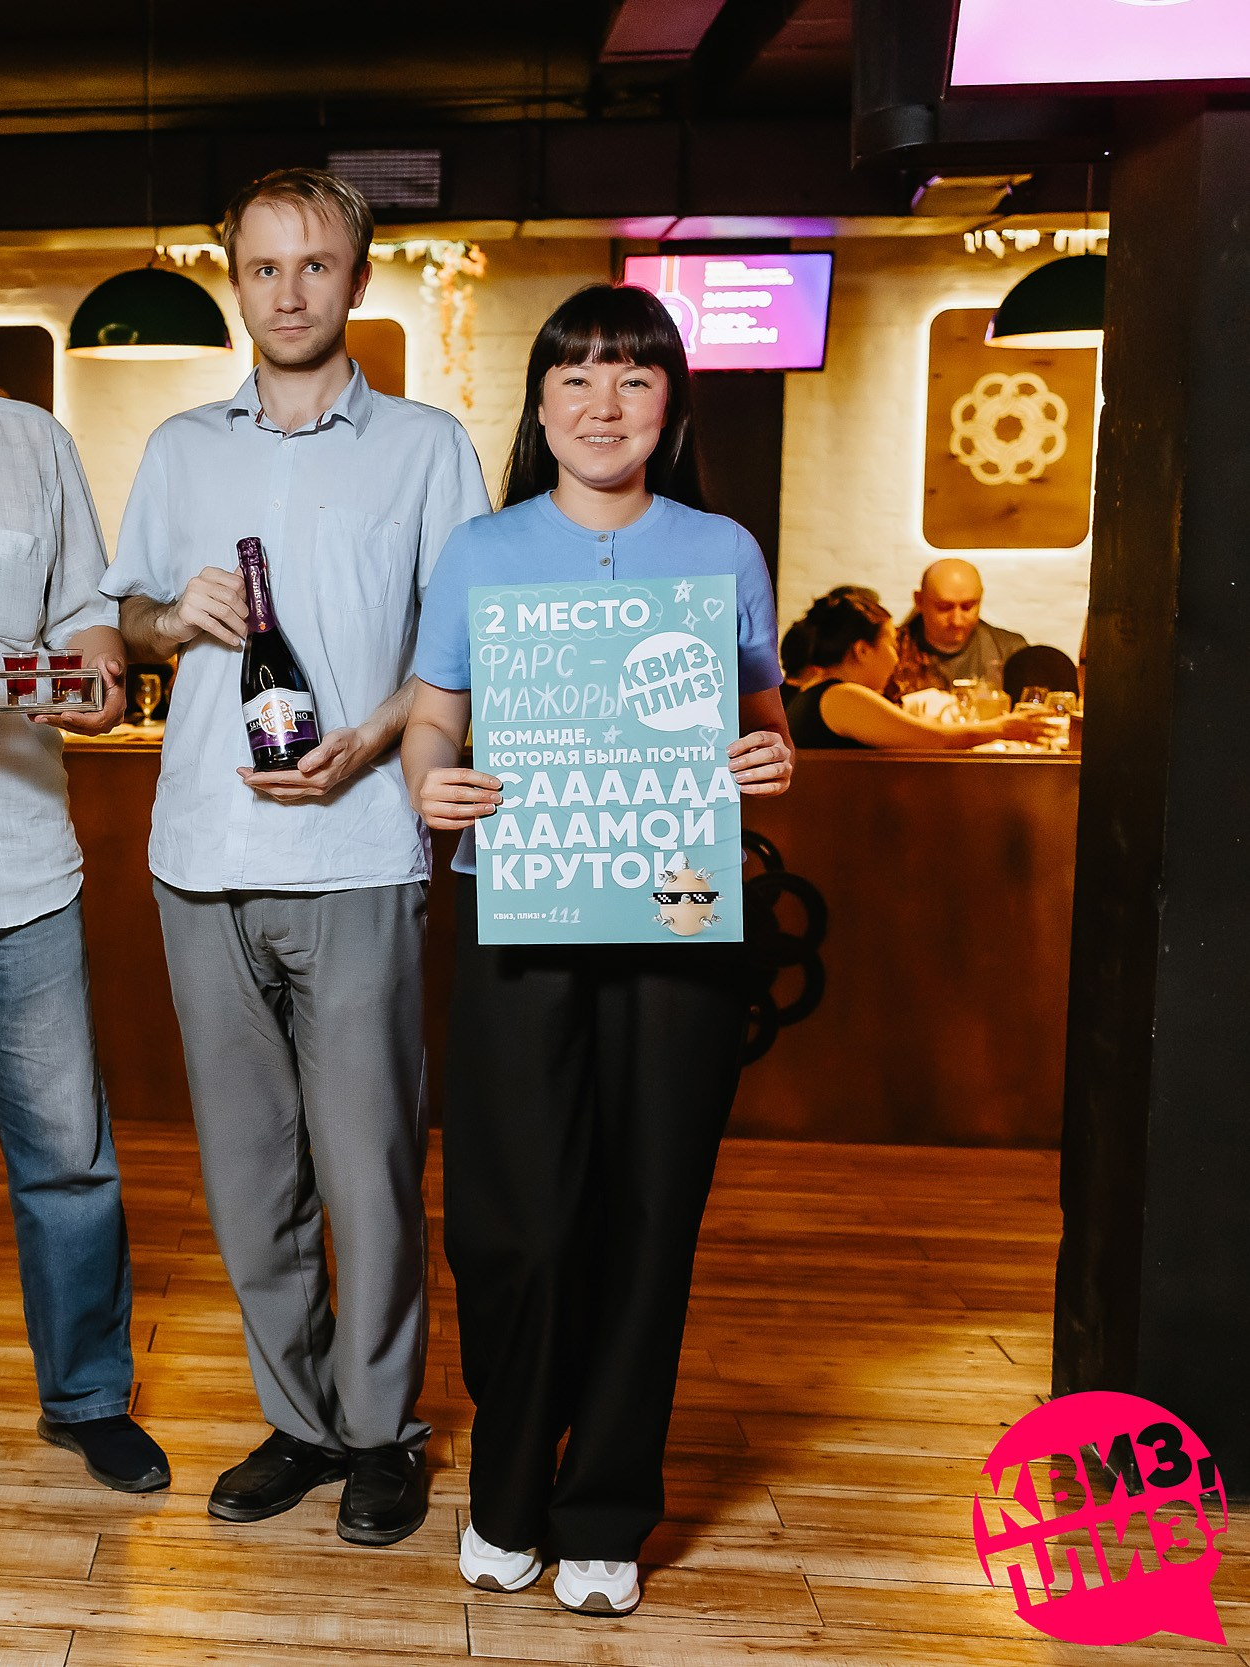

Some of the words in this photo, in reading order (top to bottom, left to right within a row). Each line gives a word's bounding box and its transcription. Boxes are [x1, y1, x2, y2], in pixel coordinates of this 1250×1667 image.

[485, 604, 506, 634] 2
[517, 598, 650, 632] МЕСТО
[478, 643, 578, 682] ФАРС
[481, 682, 622, 721] МАЖОРЫ
[488, 728, 592, 746] КОМАНДЕ,
[489, 750, 580, 767] КОТОРАЯ
[584, 748, 643, 765] БЫЛА
[646, 746, 716, 763] ПОЧТИ
[548, 906, 581, 924] 111
